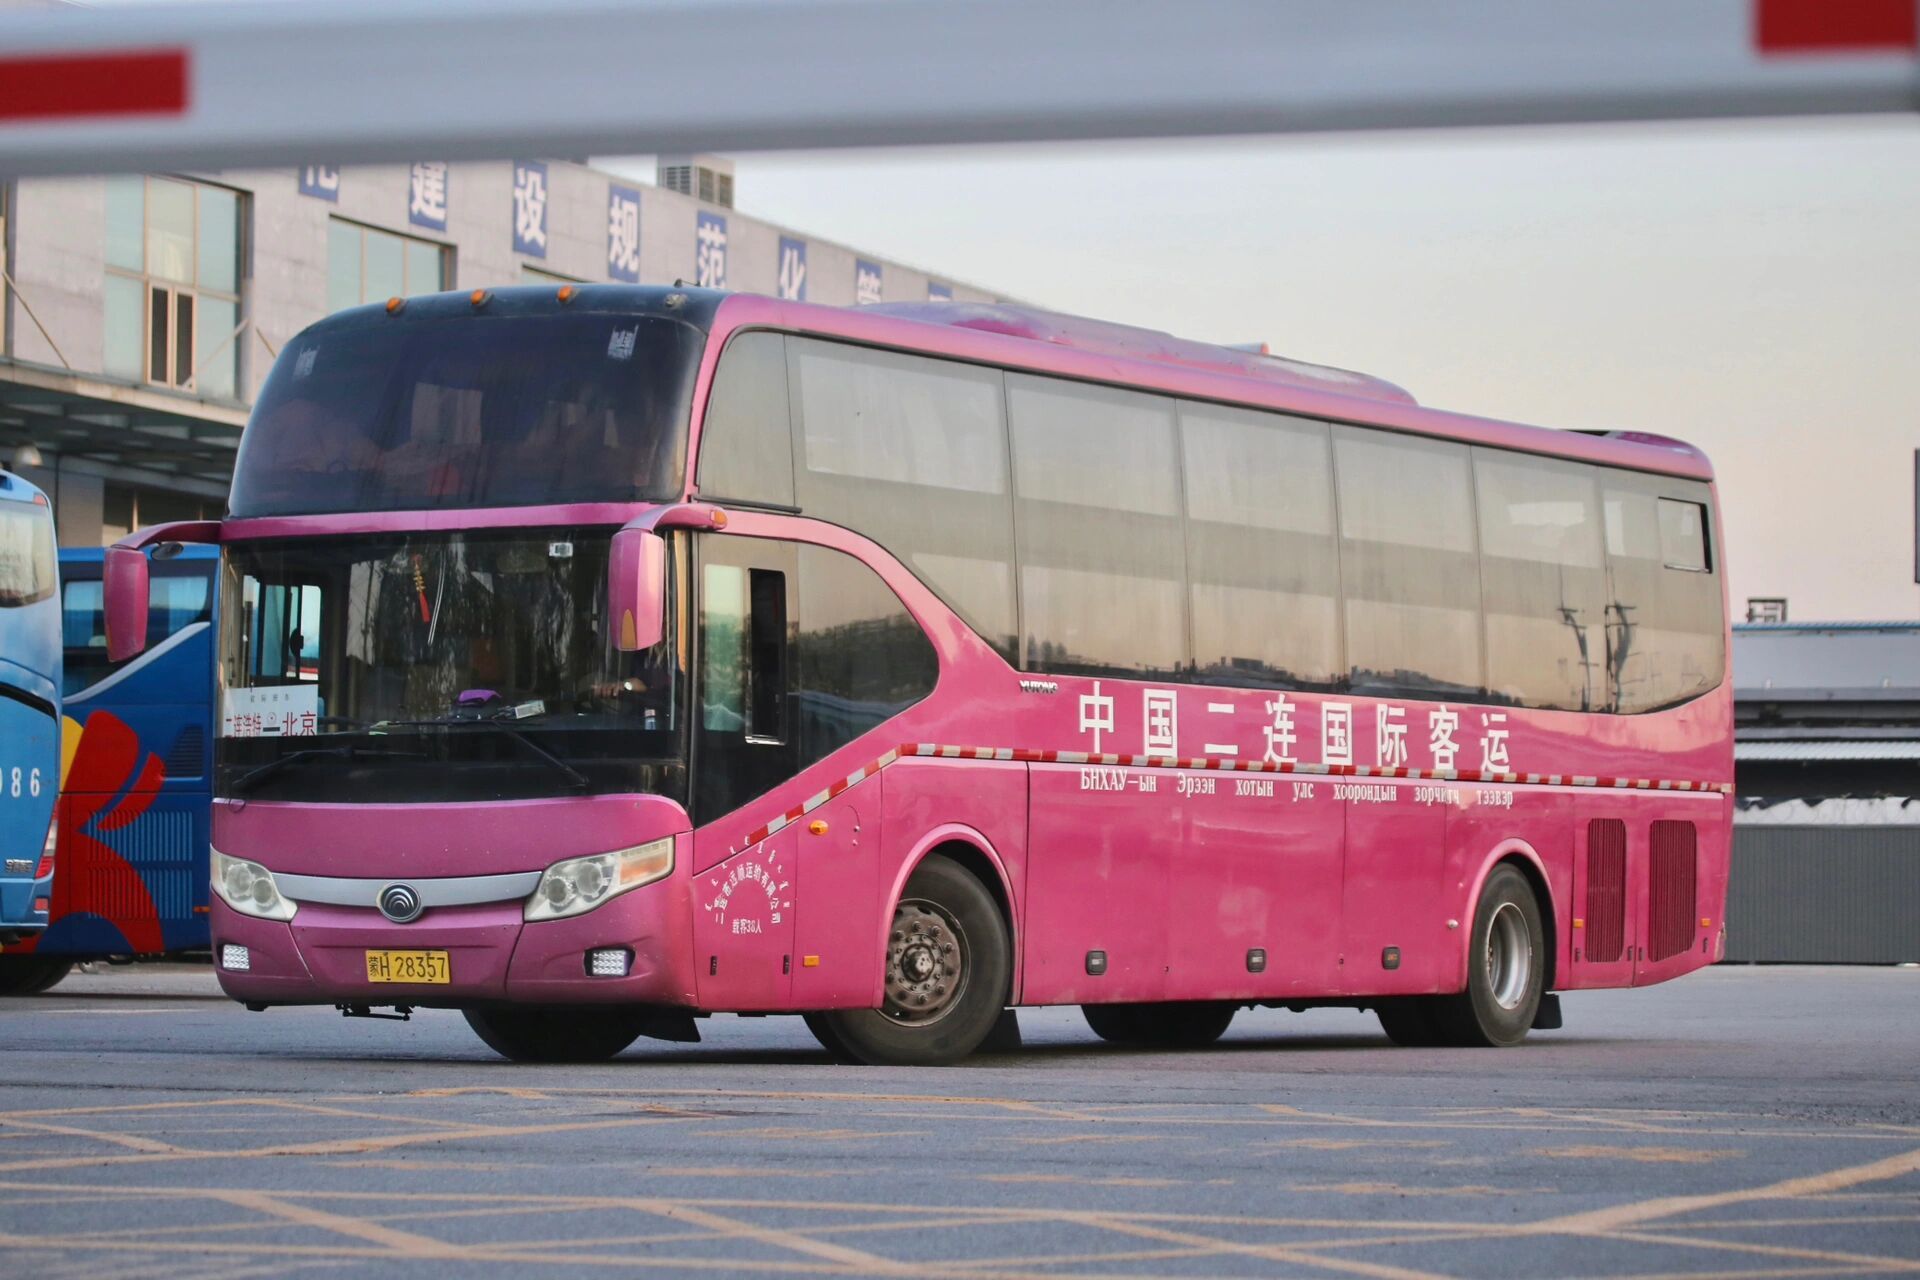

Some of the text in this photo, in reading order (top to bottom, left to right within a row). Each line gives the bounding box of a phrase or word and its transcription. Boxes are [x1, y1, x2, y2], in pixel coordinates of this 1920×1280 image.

[1079, 680, 1510, 773] 中国二连国际客运
[0, 767, 41, 798] 86
[1177, 772, 1216, 798] Эрээн
[1235, 778, 1274, 797] хотын
[1293, 782, 1315, 803] улс
[1333, 783, 1397, 804] хоорондын
[1476, 789, 1514, 810] тээвэр
